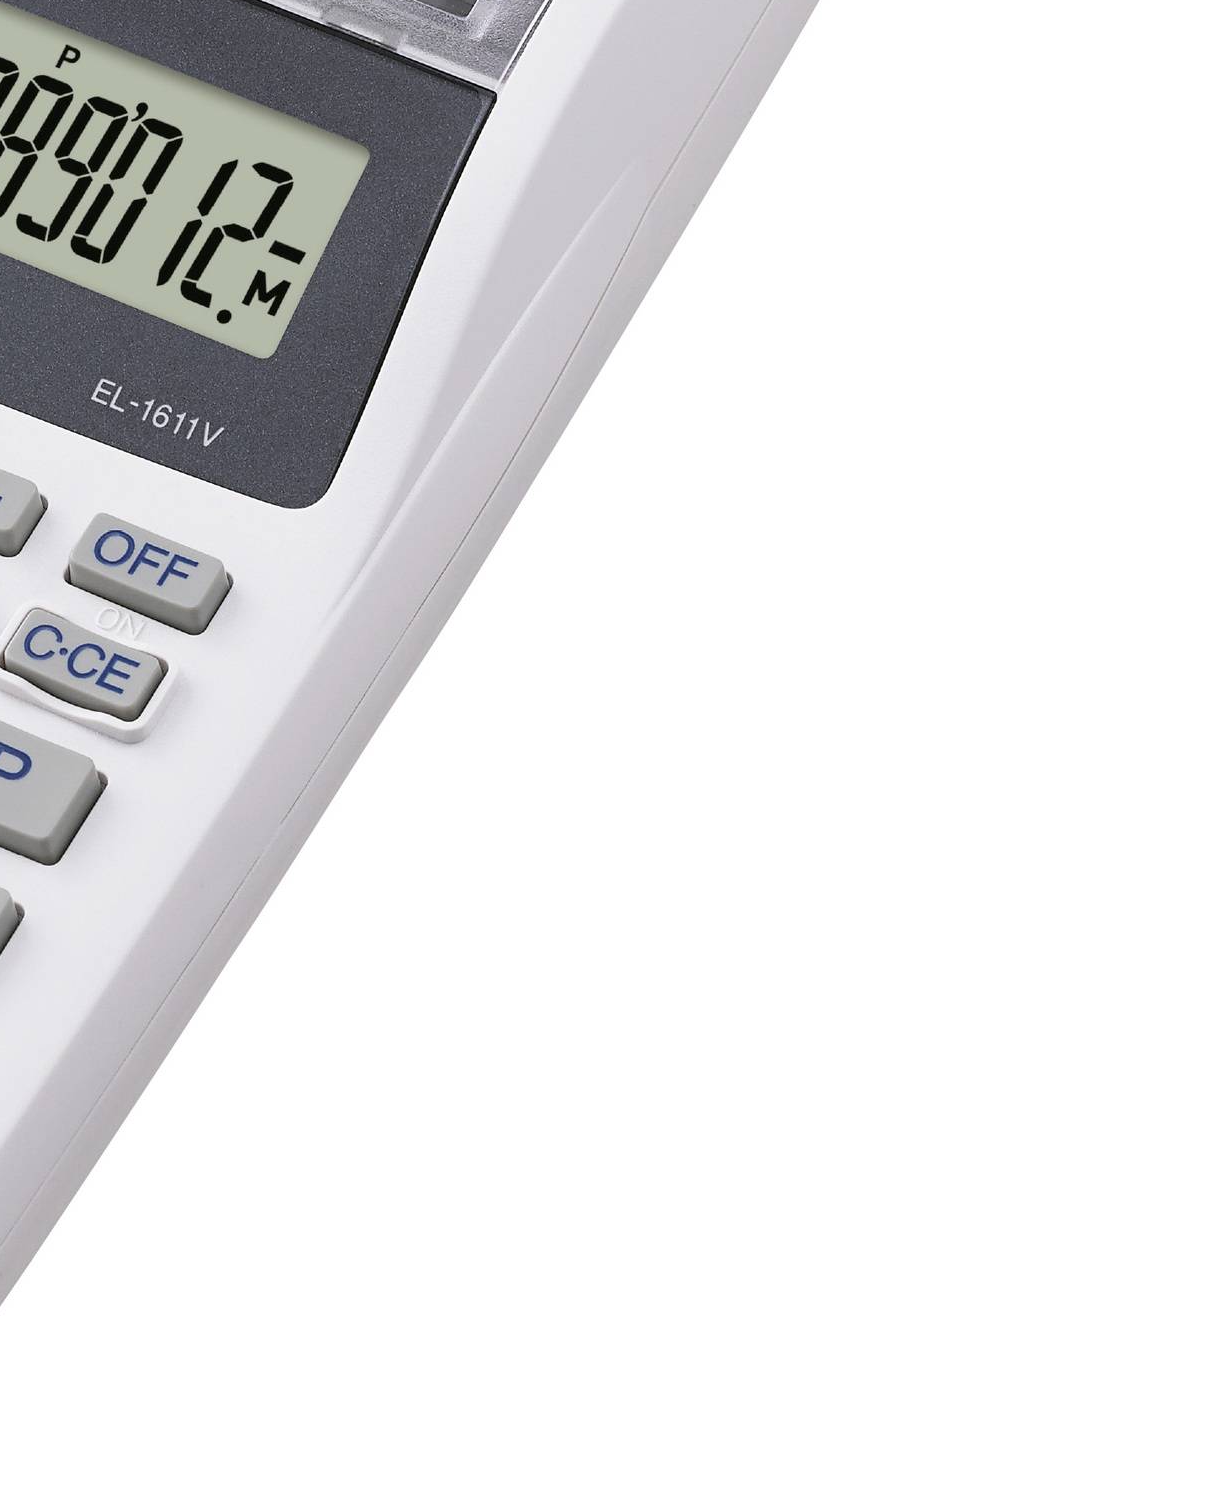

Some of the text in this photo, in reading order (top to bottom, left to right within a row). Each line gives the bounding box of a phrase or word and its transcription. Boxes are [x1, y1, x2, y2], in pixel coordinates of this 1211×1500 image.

[55, 44, 81, 69] P
[241, 270, 291, 316] M
[90, 378, 225, 448] EL-1611V
[93, 529, 199, 588] OFF
[96, 607, 146, 641] ON
